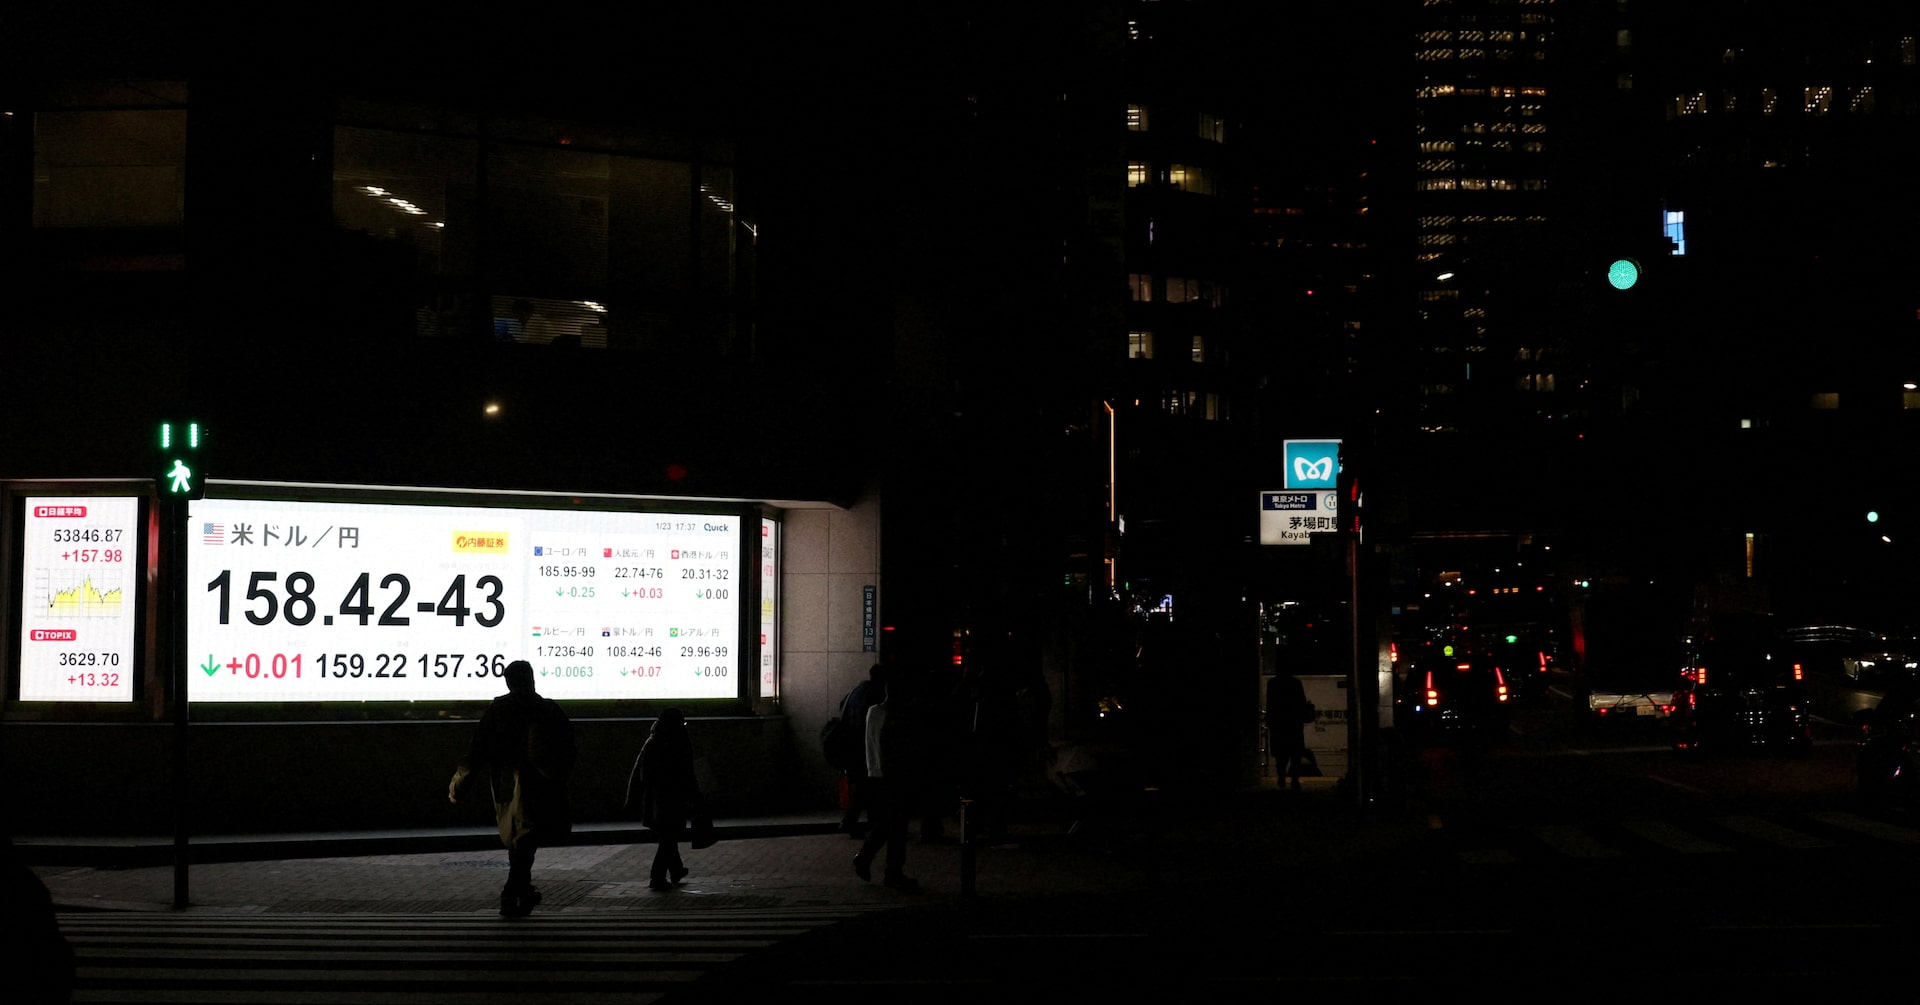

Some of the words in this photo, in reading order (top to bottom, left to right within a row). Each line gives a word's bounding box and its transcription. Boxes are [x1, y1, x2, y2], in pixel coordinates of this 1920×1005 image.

[656, 522, 671, 531] 1/23
[676, 523, 696, 531] 17:37
[704, 523, 729, 533] Quick
[53, 529, 123, 542] 53846.87
[61, 549, 123, 563] +157.98
[539, 566, 596, 578] 185.95-99
[614, 568, 664, 579] 22.74-76
[681, 569, 729, 580] 20.31-32
[567, 587, 596, 598] -0.25
[632, 588, 663, 599] +0.03
[705, 589, 729, 600] 0.00
[207, 569, 506, 628] 158.42-43
[45, 631, 71, 639] TOPIX
[537, 646, 594, 657] 1.7236-40
[606, 646, 662, 657] 108.42-46
[680, 646, 729, 657] 29.96-99
[59, 652, 120, 666] 3629.70
[226, 653, 302, 679] +0.01
[316, 653, 408, 678] 159.22
[417, 653, 505, 678] 157.36
[630, 666, 662, 677] +0.07
[704, 666, 728, 677] 0.00
[551, 666, 594, 678] -0.0063
[67, 673, 119, 687] +13.32
